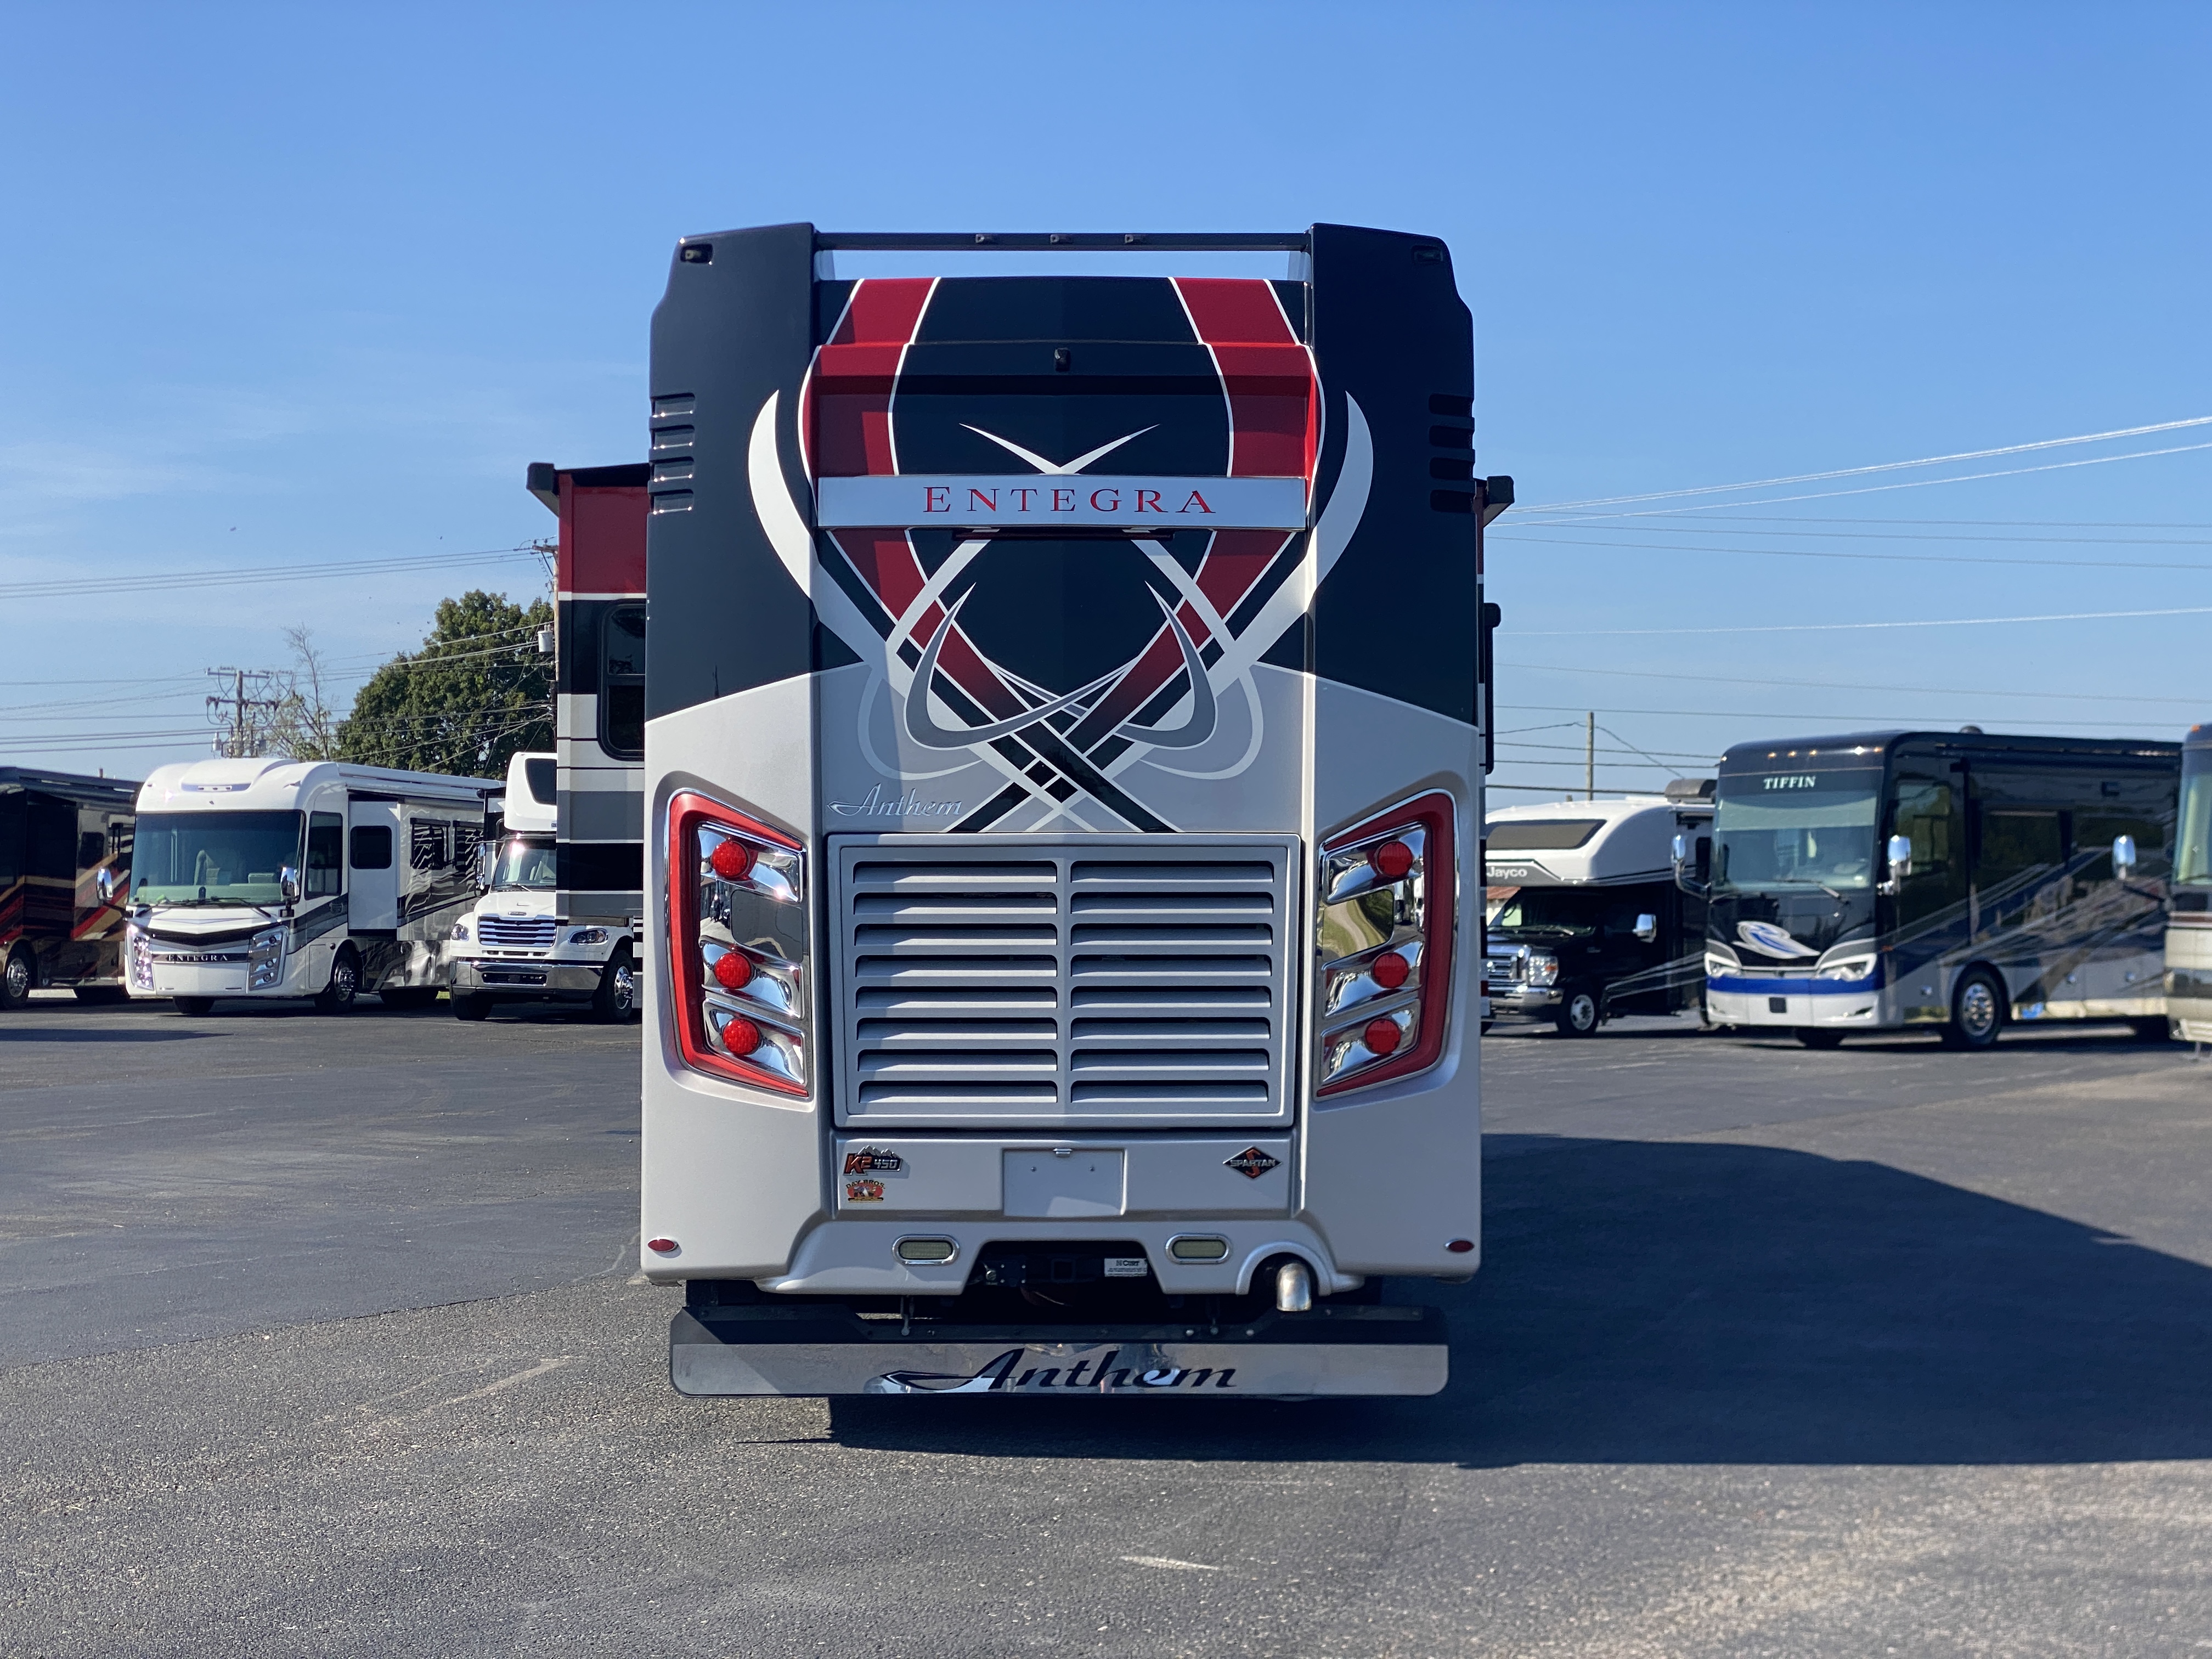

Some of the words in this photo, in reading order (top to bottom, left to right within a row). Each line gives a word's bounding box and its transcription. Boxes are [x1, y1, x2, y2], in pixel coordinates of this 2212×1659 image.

[923, 486, 1216, 514] ENTEGRA
[1763, 776, 1816, 789] TIFFIN
[827, 782, 962, 816] Anthem
[1486, 866, 1527, 879] Jayco
[845, 1155, 872, 1173] K2
[874, 1159, 898, 1169] 450
[845, 1180, 861, 1189] DAY
[879, 1347, 1237, 1391] Anthem
